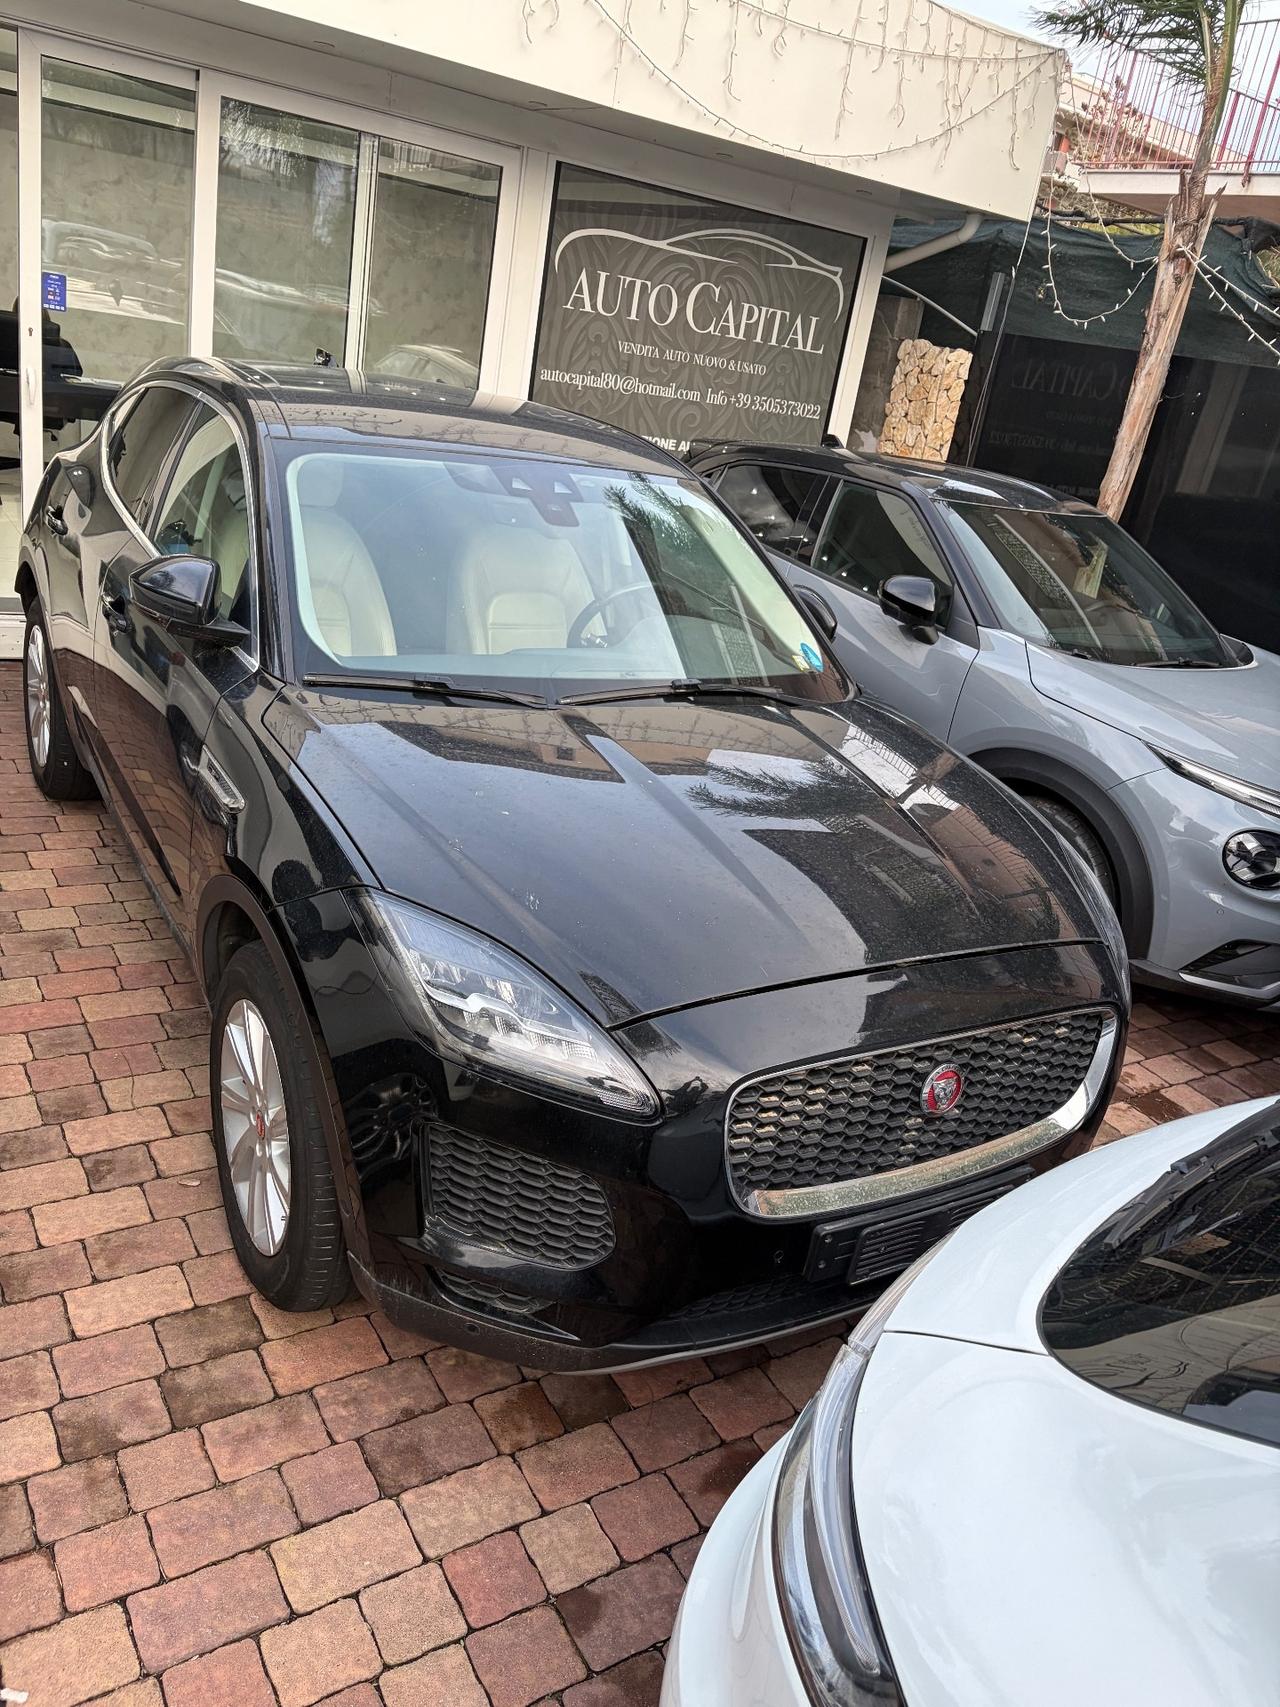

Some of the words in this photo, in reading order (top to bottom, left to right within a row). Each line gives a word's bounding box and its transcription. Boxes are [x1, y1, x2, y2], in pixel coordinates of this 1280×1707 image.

[562, 267, 678, 326] AUTO
[686, 282, 824, 355] CAPITAL
[618, 340, 660, 358] VENDITA
[663, 349, 690, 364] AUTO
[693, 353, 727, 369] NUOVO
[540, 368, 701, 402] autocapital80@hotmail.com
[706, 387, 728, 406] Info
